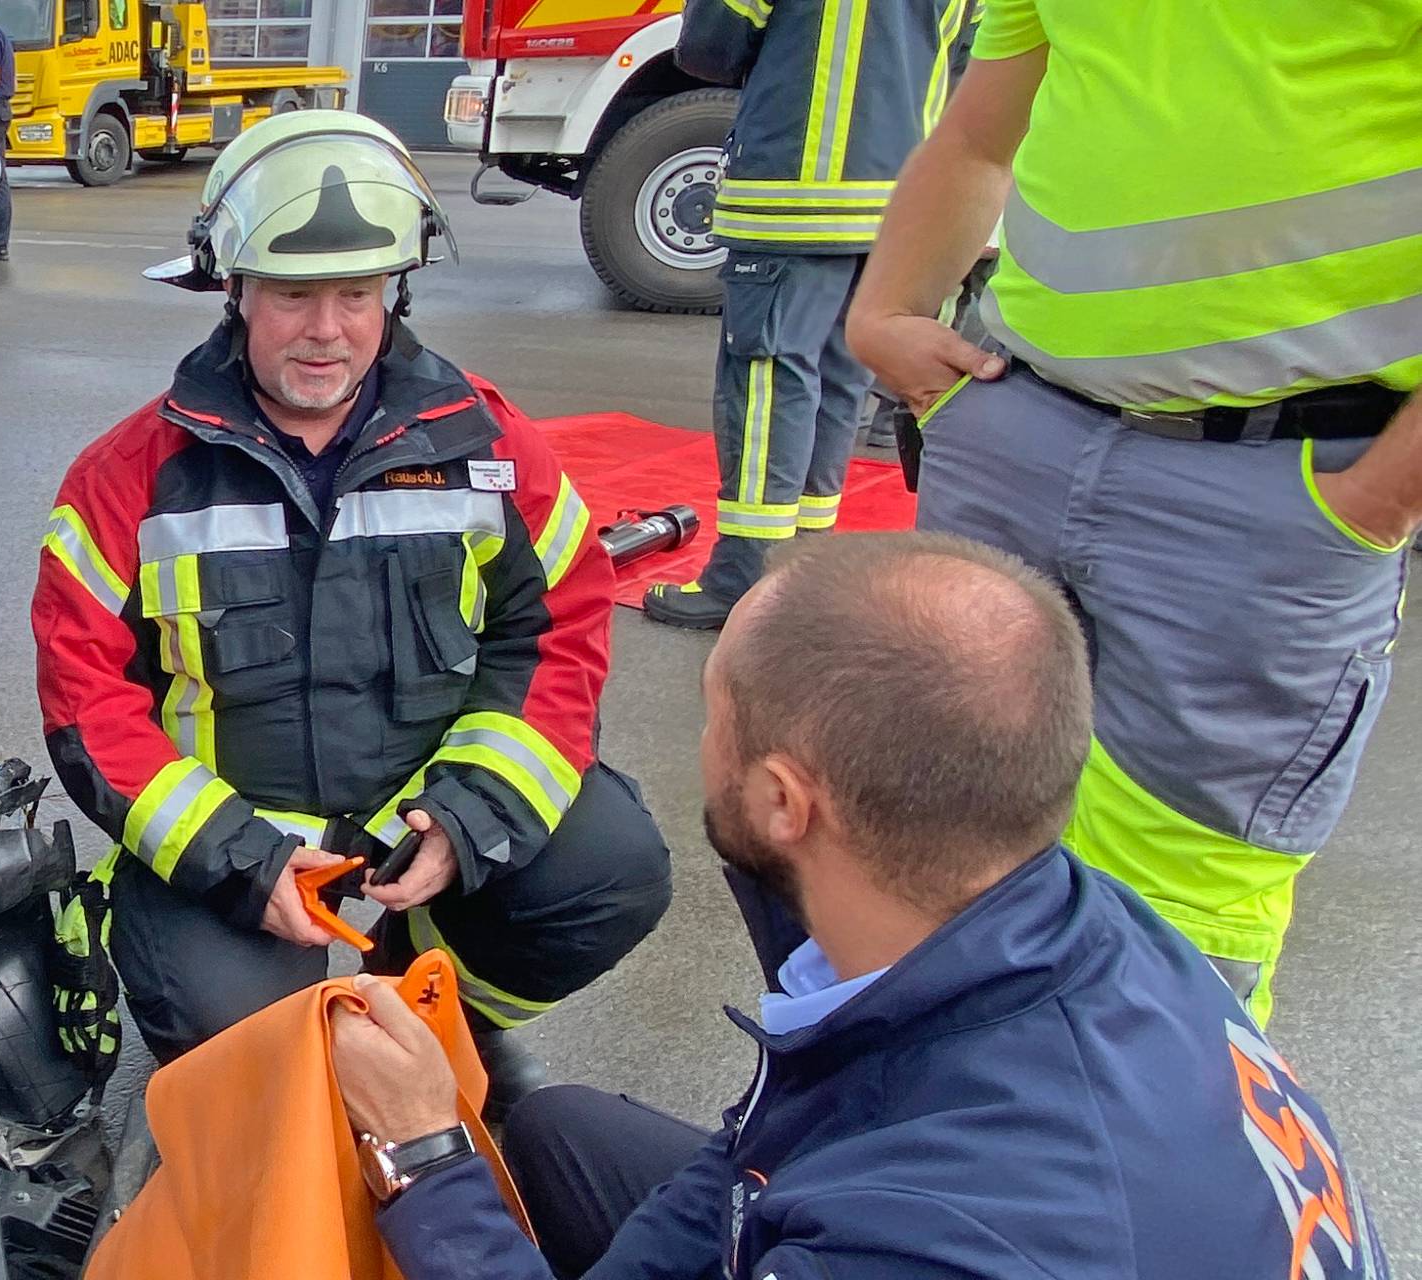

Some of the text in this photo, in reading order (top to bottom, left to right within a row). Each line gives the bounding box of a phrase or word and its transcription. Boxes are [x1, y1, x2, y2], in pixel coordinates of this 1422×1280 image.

[108, 41, 139, 63] ADAC
[373, 62, 388, 73] K6
[385, 469, 445, 484] Rausch J.
